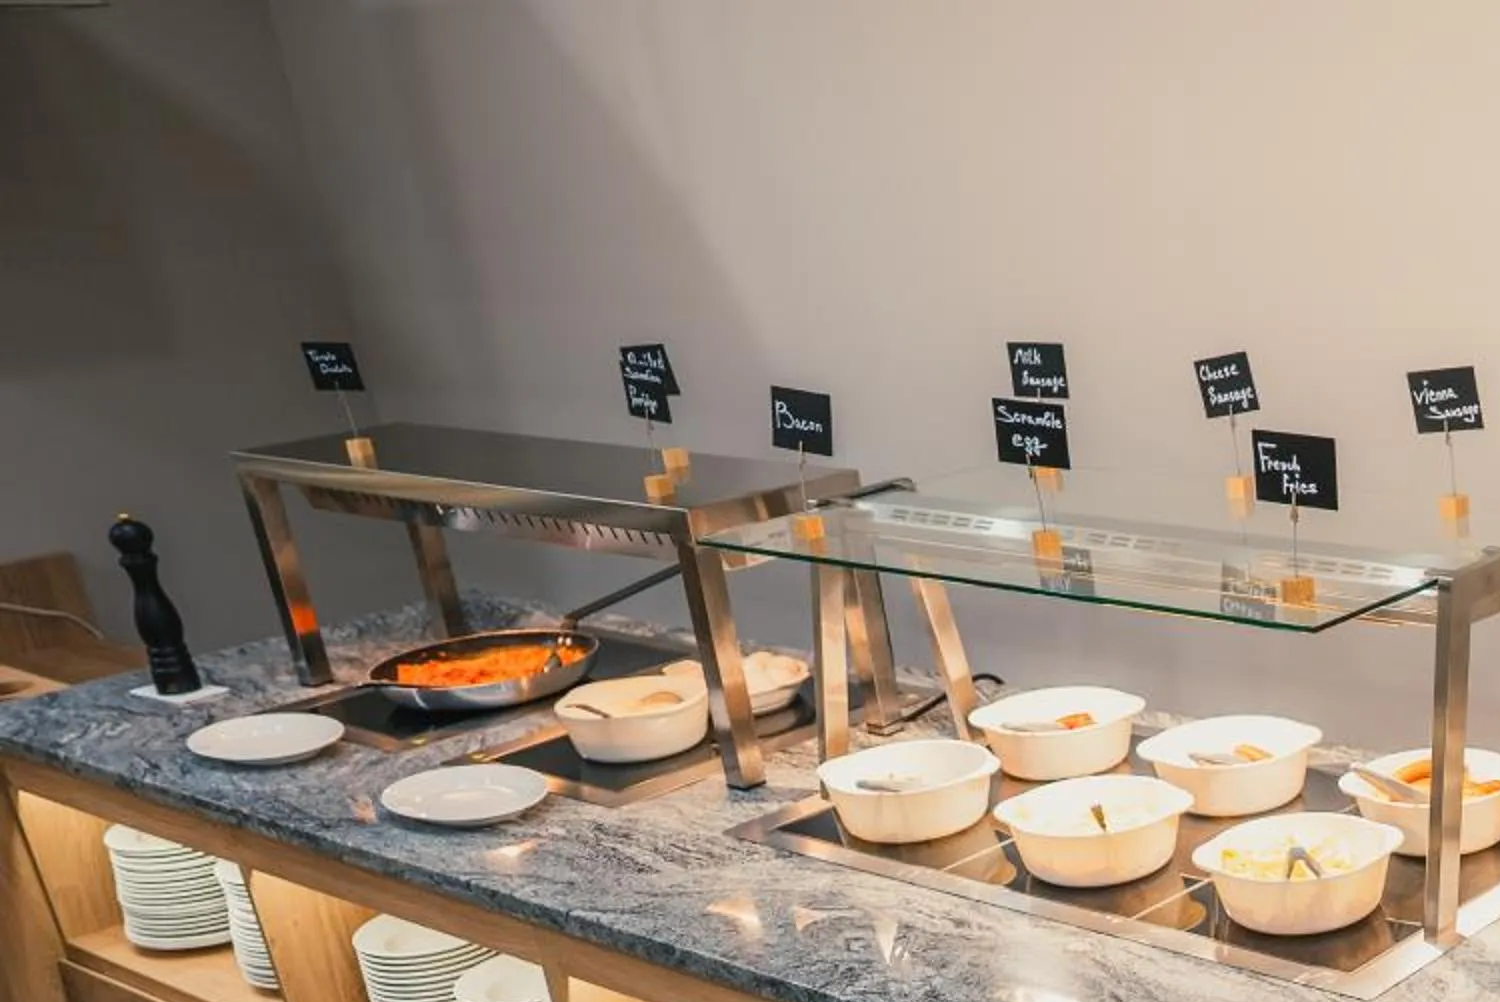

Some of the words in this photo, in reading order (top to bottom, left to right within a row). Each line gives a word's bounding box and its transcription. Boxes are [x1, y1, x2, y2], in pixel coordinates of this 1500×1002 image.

[1013, 348, 1041, 365] Milk
[1022, 370, 1066, 393] Sausage
[1200, 363, 1240, 382] Cheese
[1208, 385, 1255, 408] Sausage
[775, 399, 823, 433] Bacon
[996, 405, 1062, 429] Scramble
[1011, 433, 1048, 456] egg
[1258, 441, 1301, 473] French
